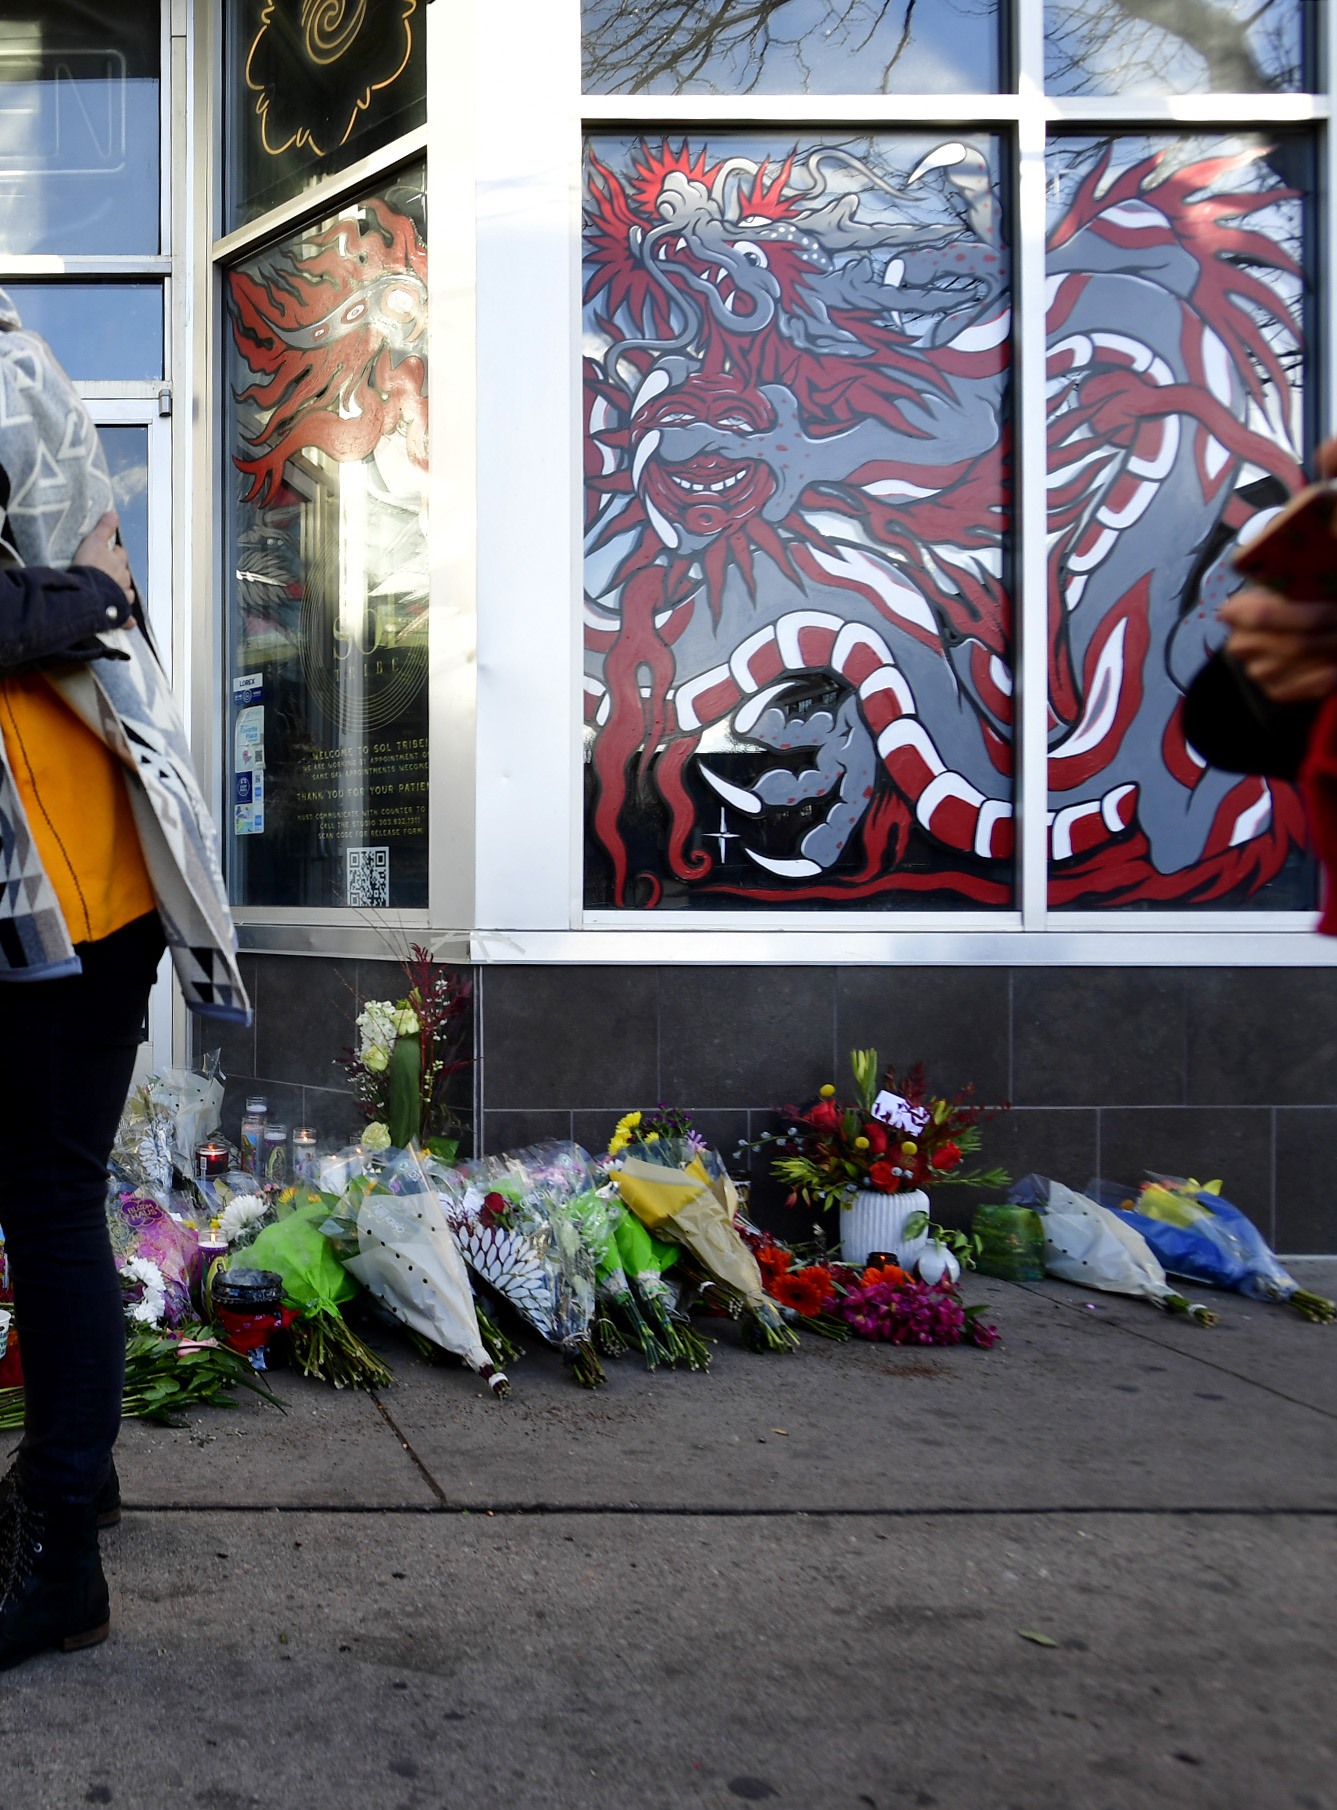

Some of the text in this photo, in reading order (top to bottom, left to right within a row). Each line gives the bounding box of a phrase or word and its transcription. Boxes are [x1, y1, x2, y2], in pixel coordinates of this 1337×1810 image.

[334, 658, 399, 682] TRIBE
[239, 678, 255, 687] LOREX
[312, 748, 353, 760] WELCOME
[357, 746, 370, 755] TO
[374, 743, 392, 753] SOL
[370, 752, 419, 763] APPOINTMENT
[312, 772, 328, 780] SAME
[345, 765, 395, 777] APPOINTMENTS
[296, 792, 323, 801] THANK
[328, 789, 344, 799] YOU
[348, 787, 365, 797] FOR
[370, 785, 394, 795] YOUR
[381, 806, 413, 815] COUNTER
[416, 805, 426, 813] TO
[370, 829, 400, 837] RELEASE
[404, 827, 423, 835] FORM
